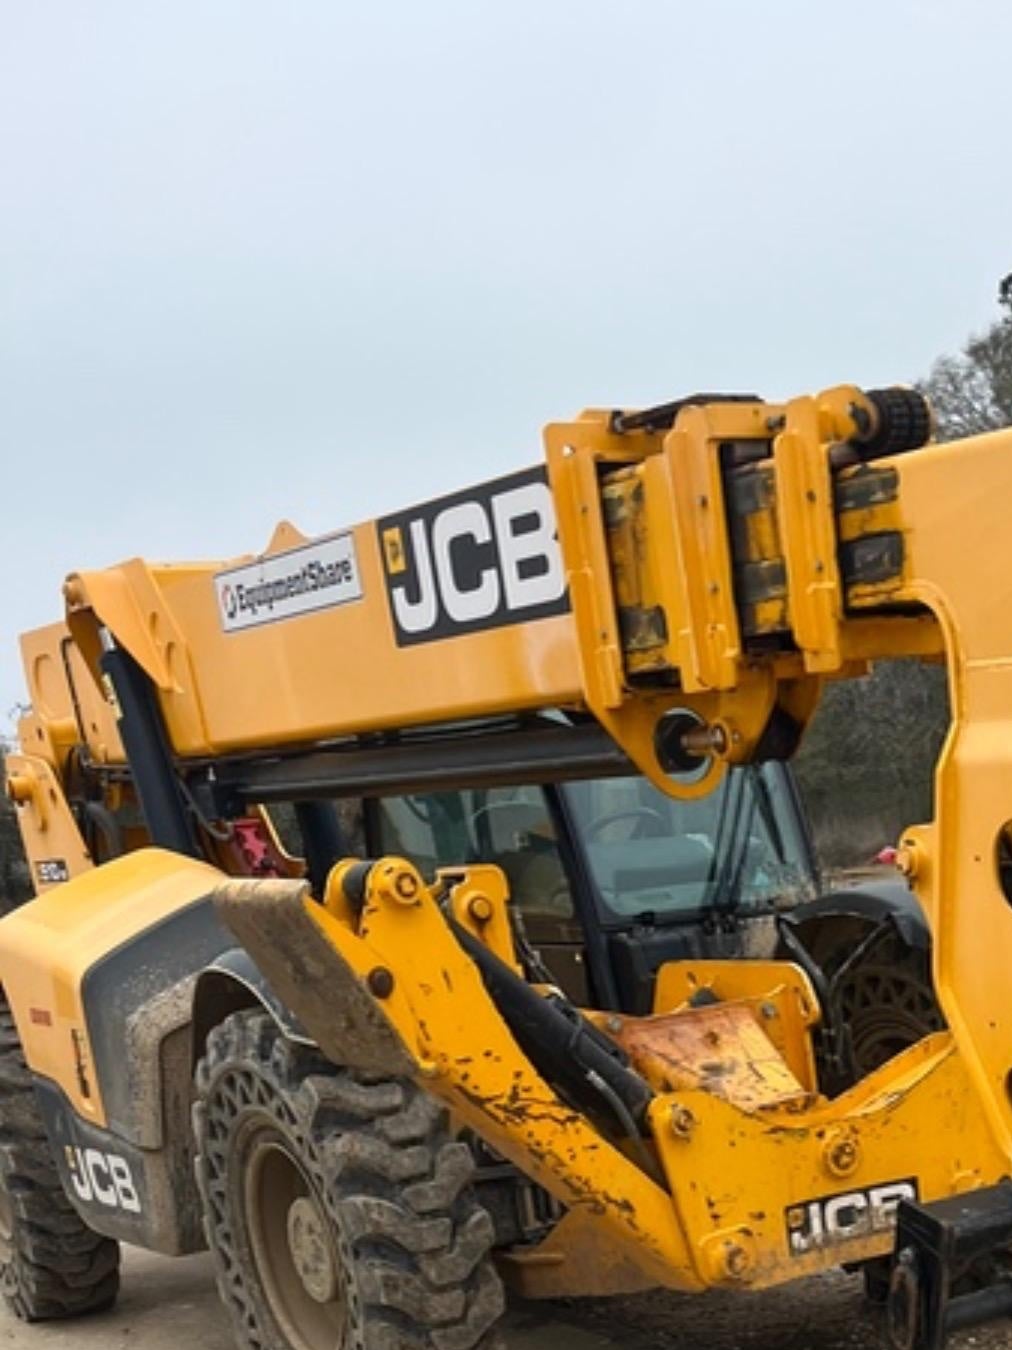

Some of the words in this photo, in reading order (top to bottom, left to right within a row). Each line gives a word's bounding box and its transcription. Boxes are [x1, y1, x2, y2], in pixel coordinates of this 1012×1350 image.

[236, 559, 352, 614] EquipmentShare
[391, 482, 568, 633] JCB
[70, 1147, 141, 1213] JCB
